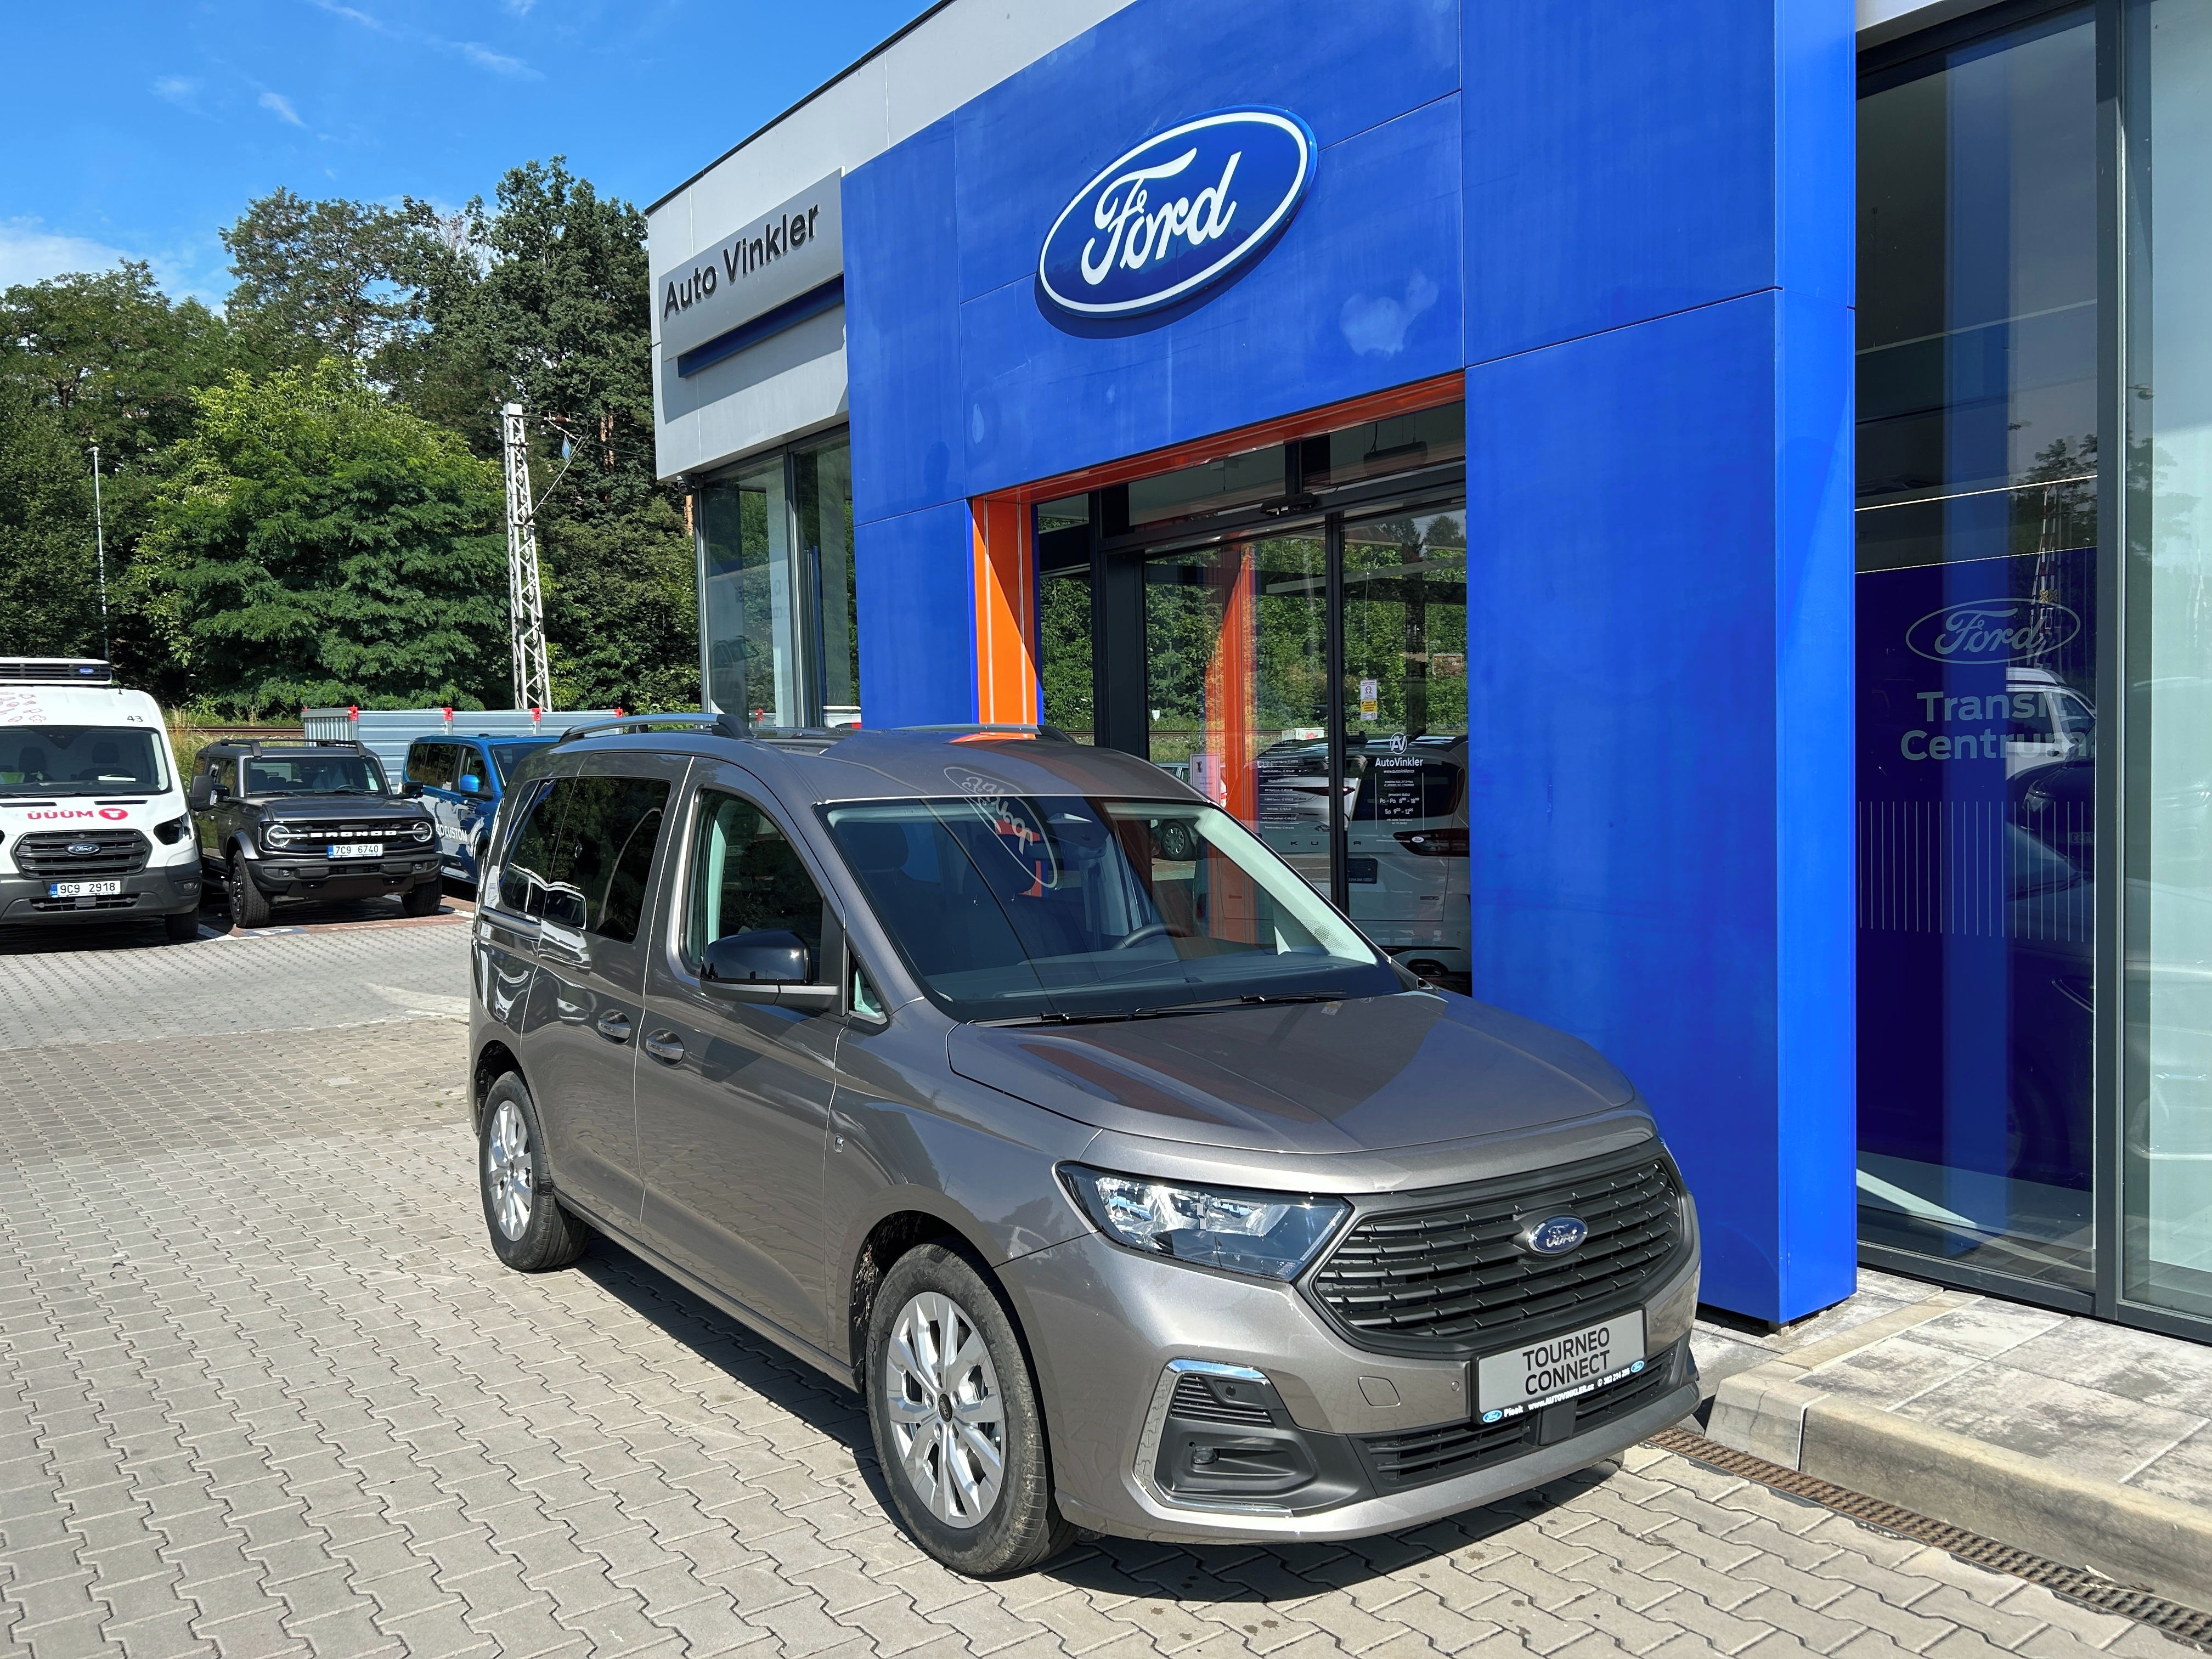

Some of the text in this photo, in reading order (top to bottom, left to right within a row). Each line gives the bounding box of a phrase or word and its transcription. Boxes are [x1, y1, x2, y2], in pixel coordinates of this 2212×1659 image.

[1081, 148, 1242, 285] Ford
[664, 204, 819, 321] Auto Vinkler
[1934, 608, 2048, 654] Ford
[1917, 691, 2067, 721] Transit
[1375, 757, 1423, 767] AutoVinkler
[444, 826, 468, 842] CUSTOM
[336, 846, 351, 854] 7C9
[358, 845, 379, 854] 6740
[60, 882, 115, 894] 9C9 2918
[1547, 1223, 1578, 1248] Ford
[1522, 1327, 1610, 1372] TOURNEO
[1525, 1349, 1610, 1396] CONNECT
